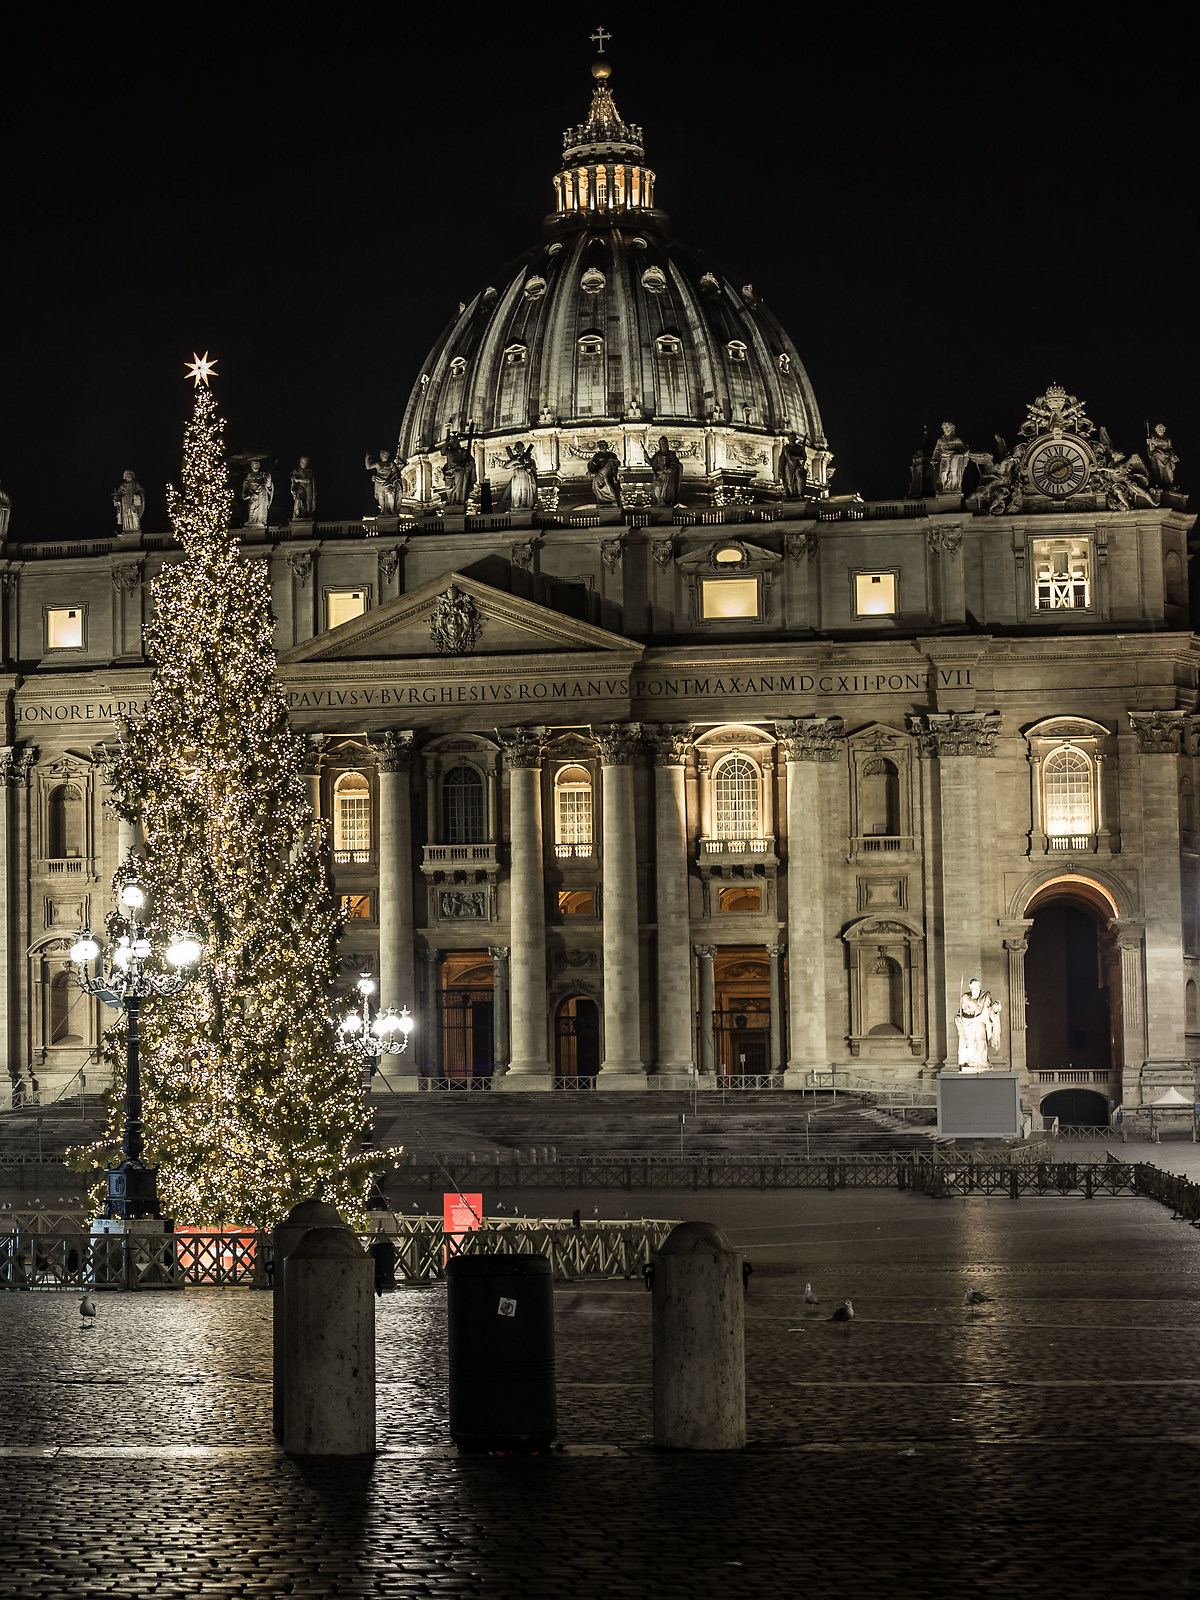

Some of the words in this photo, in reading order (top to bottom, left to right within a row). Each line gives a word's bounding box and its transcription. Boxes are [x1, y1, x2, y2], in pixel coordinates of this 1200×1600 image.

[14, 703, 114, 722] HONOREM
[290, 690, 359, 707] PAVLVS
[381, 684, 513, 704] BVRGHESIVS
[518, 679, 630, 699] ROMANVS
[635, 678, 692, 696] PONT
[693, 676, 742, 694] MAX
[745, 676, 776, 692] AN
[875, 672, 935, 690] PONT
[940, 669, 972, 686] VII
